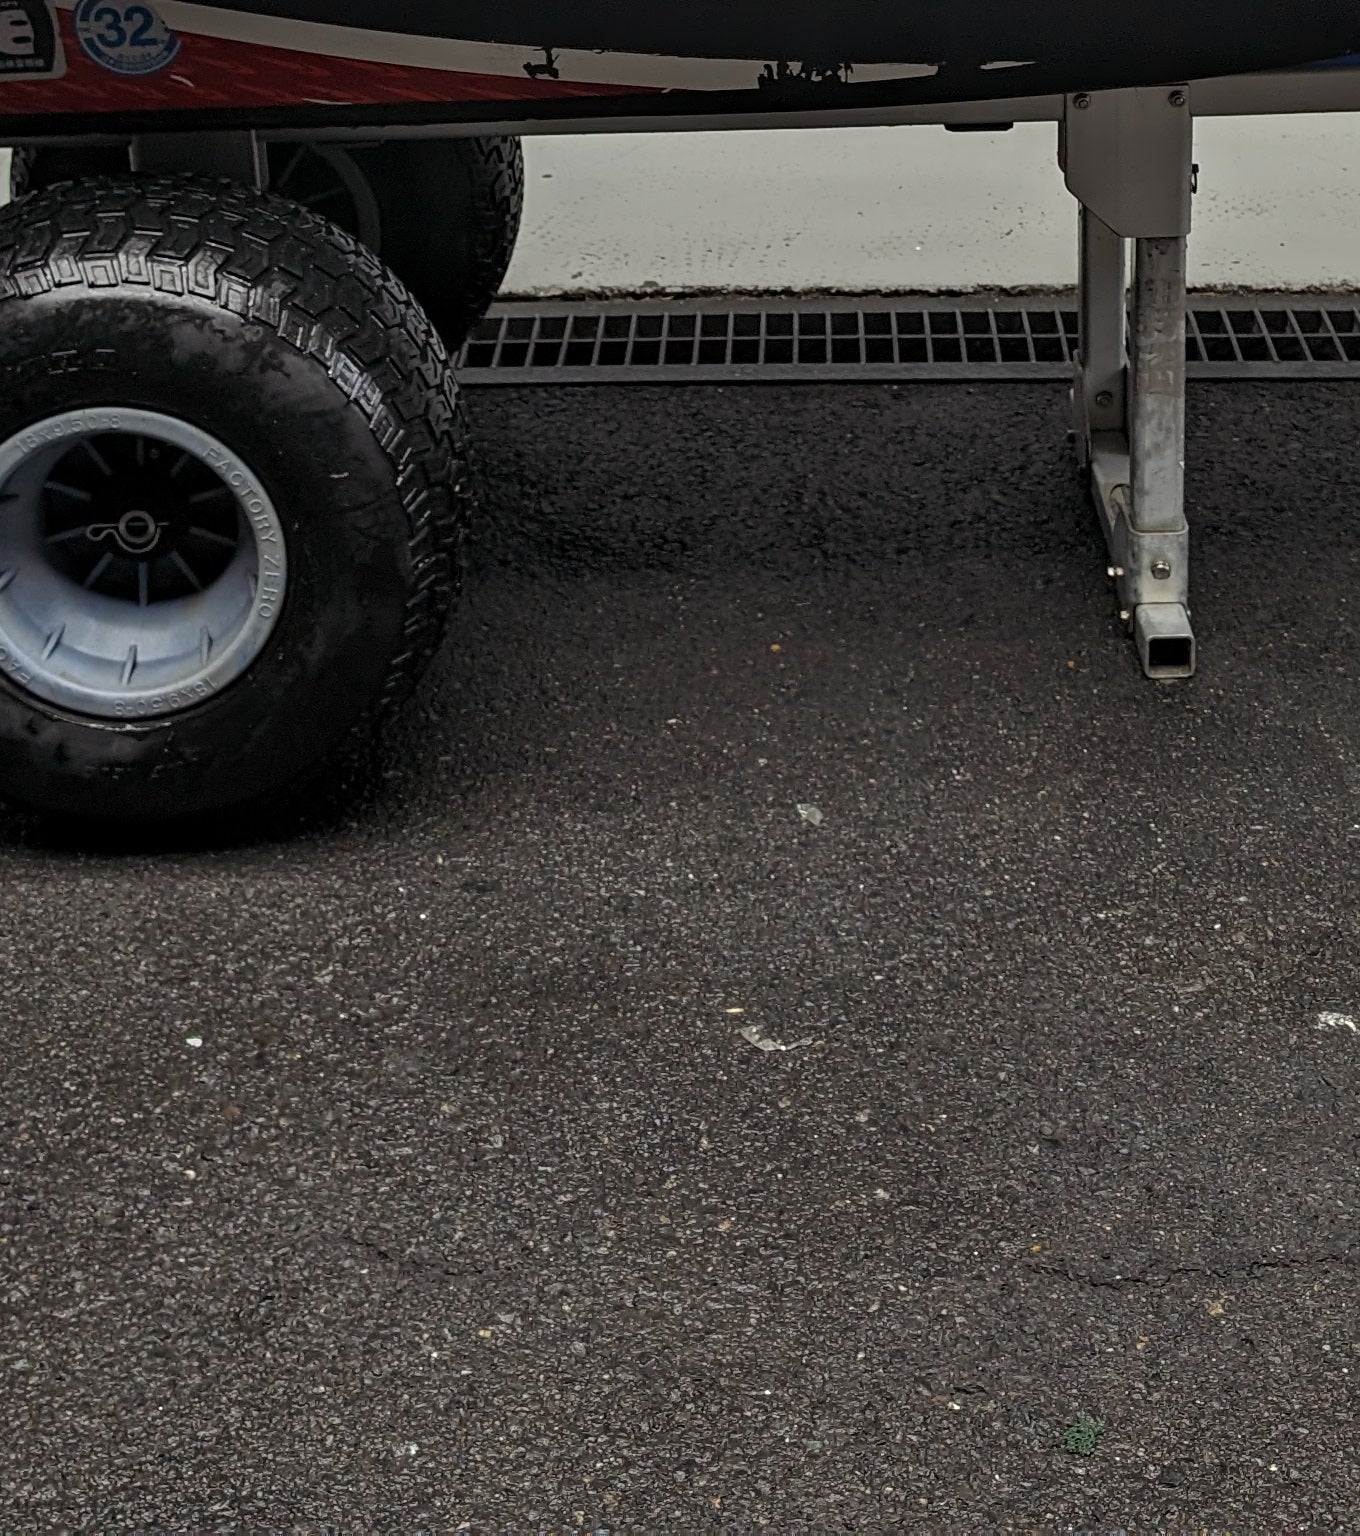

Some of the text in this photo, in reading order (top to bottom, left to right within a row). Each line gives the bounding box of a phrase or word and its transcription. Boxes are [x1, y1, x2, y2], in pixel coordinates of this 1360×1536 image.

[94, 6, 158, 48] 32
[203, 447, 281, 617] FACTORY ZERO
